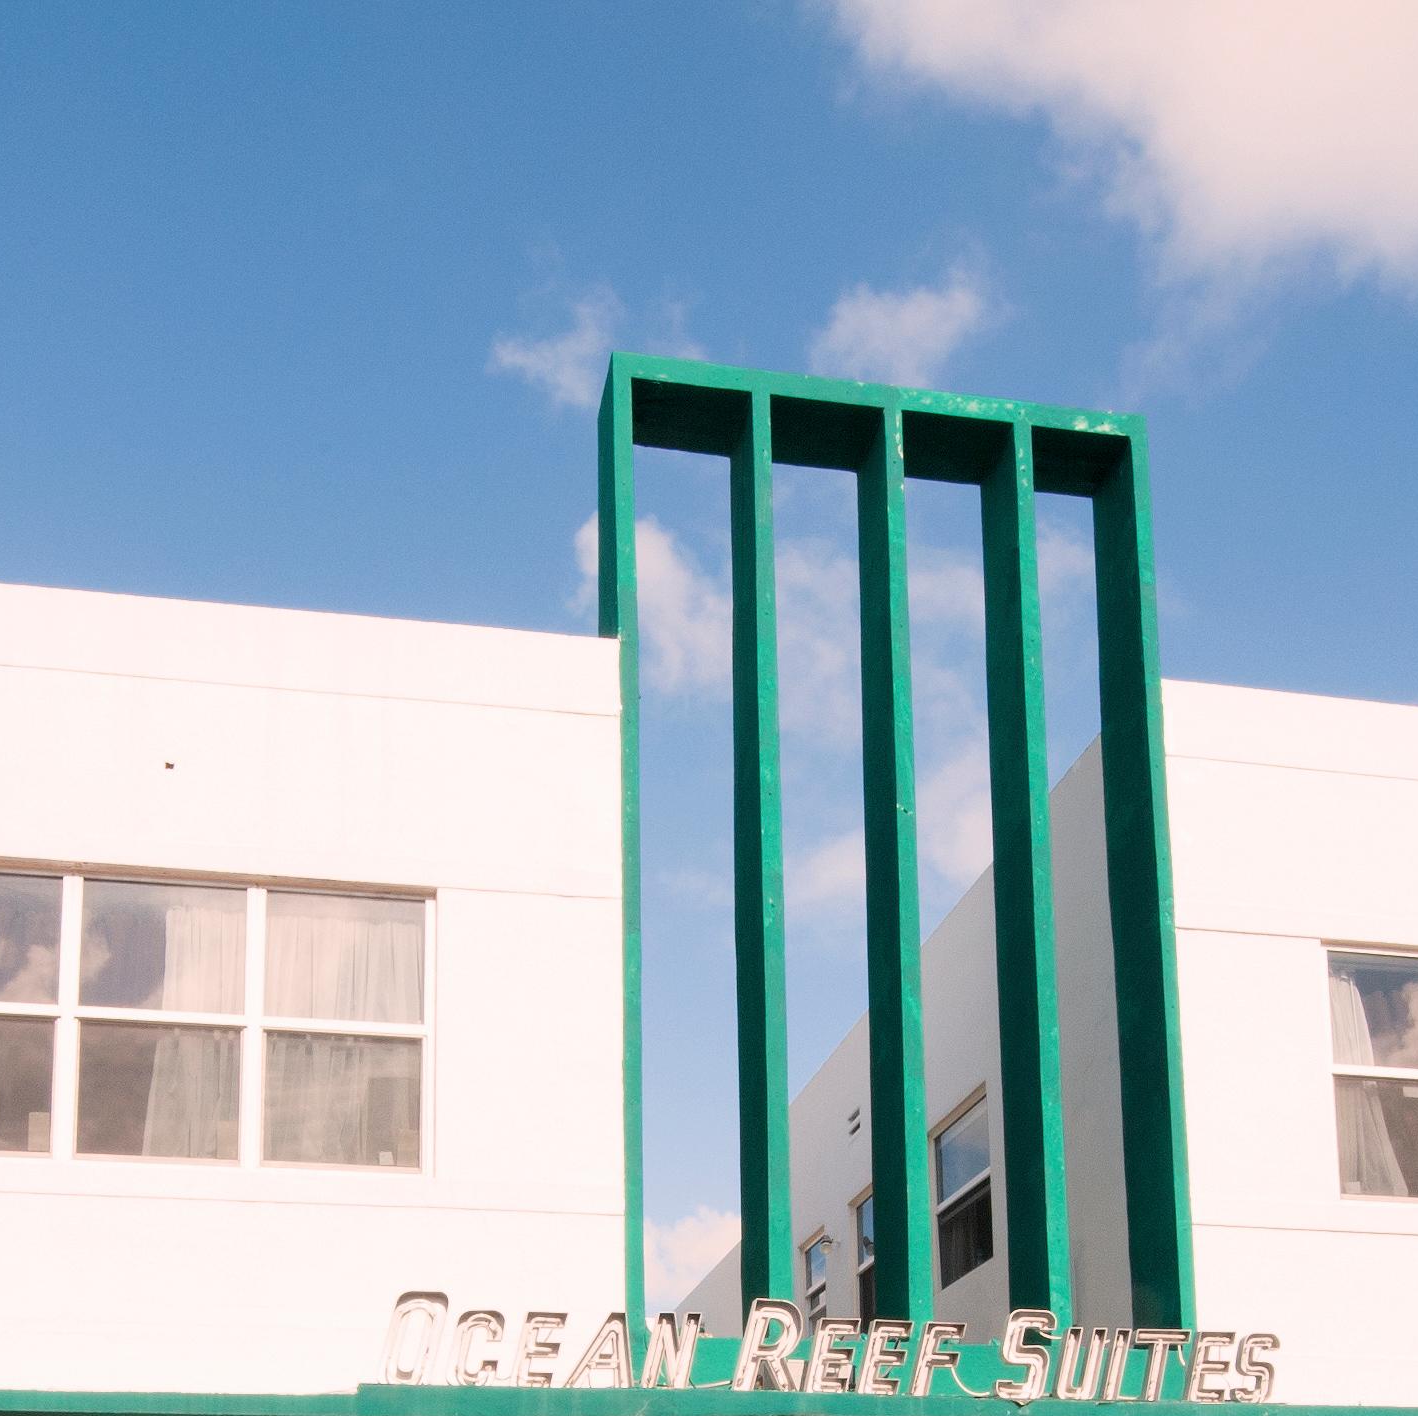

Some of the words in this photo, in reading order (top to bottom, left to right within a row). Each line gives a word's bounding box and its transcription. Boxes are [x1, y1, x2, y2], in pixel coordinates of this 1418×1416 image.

[385, 1291, 701, 1389] OCEAN
[732, 1297, 967, 1397] REEF
[995, 1308, 1280, 1404] SUITES
